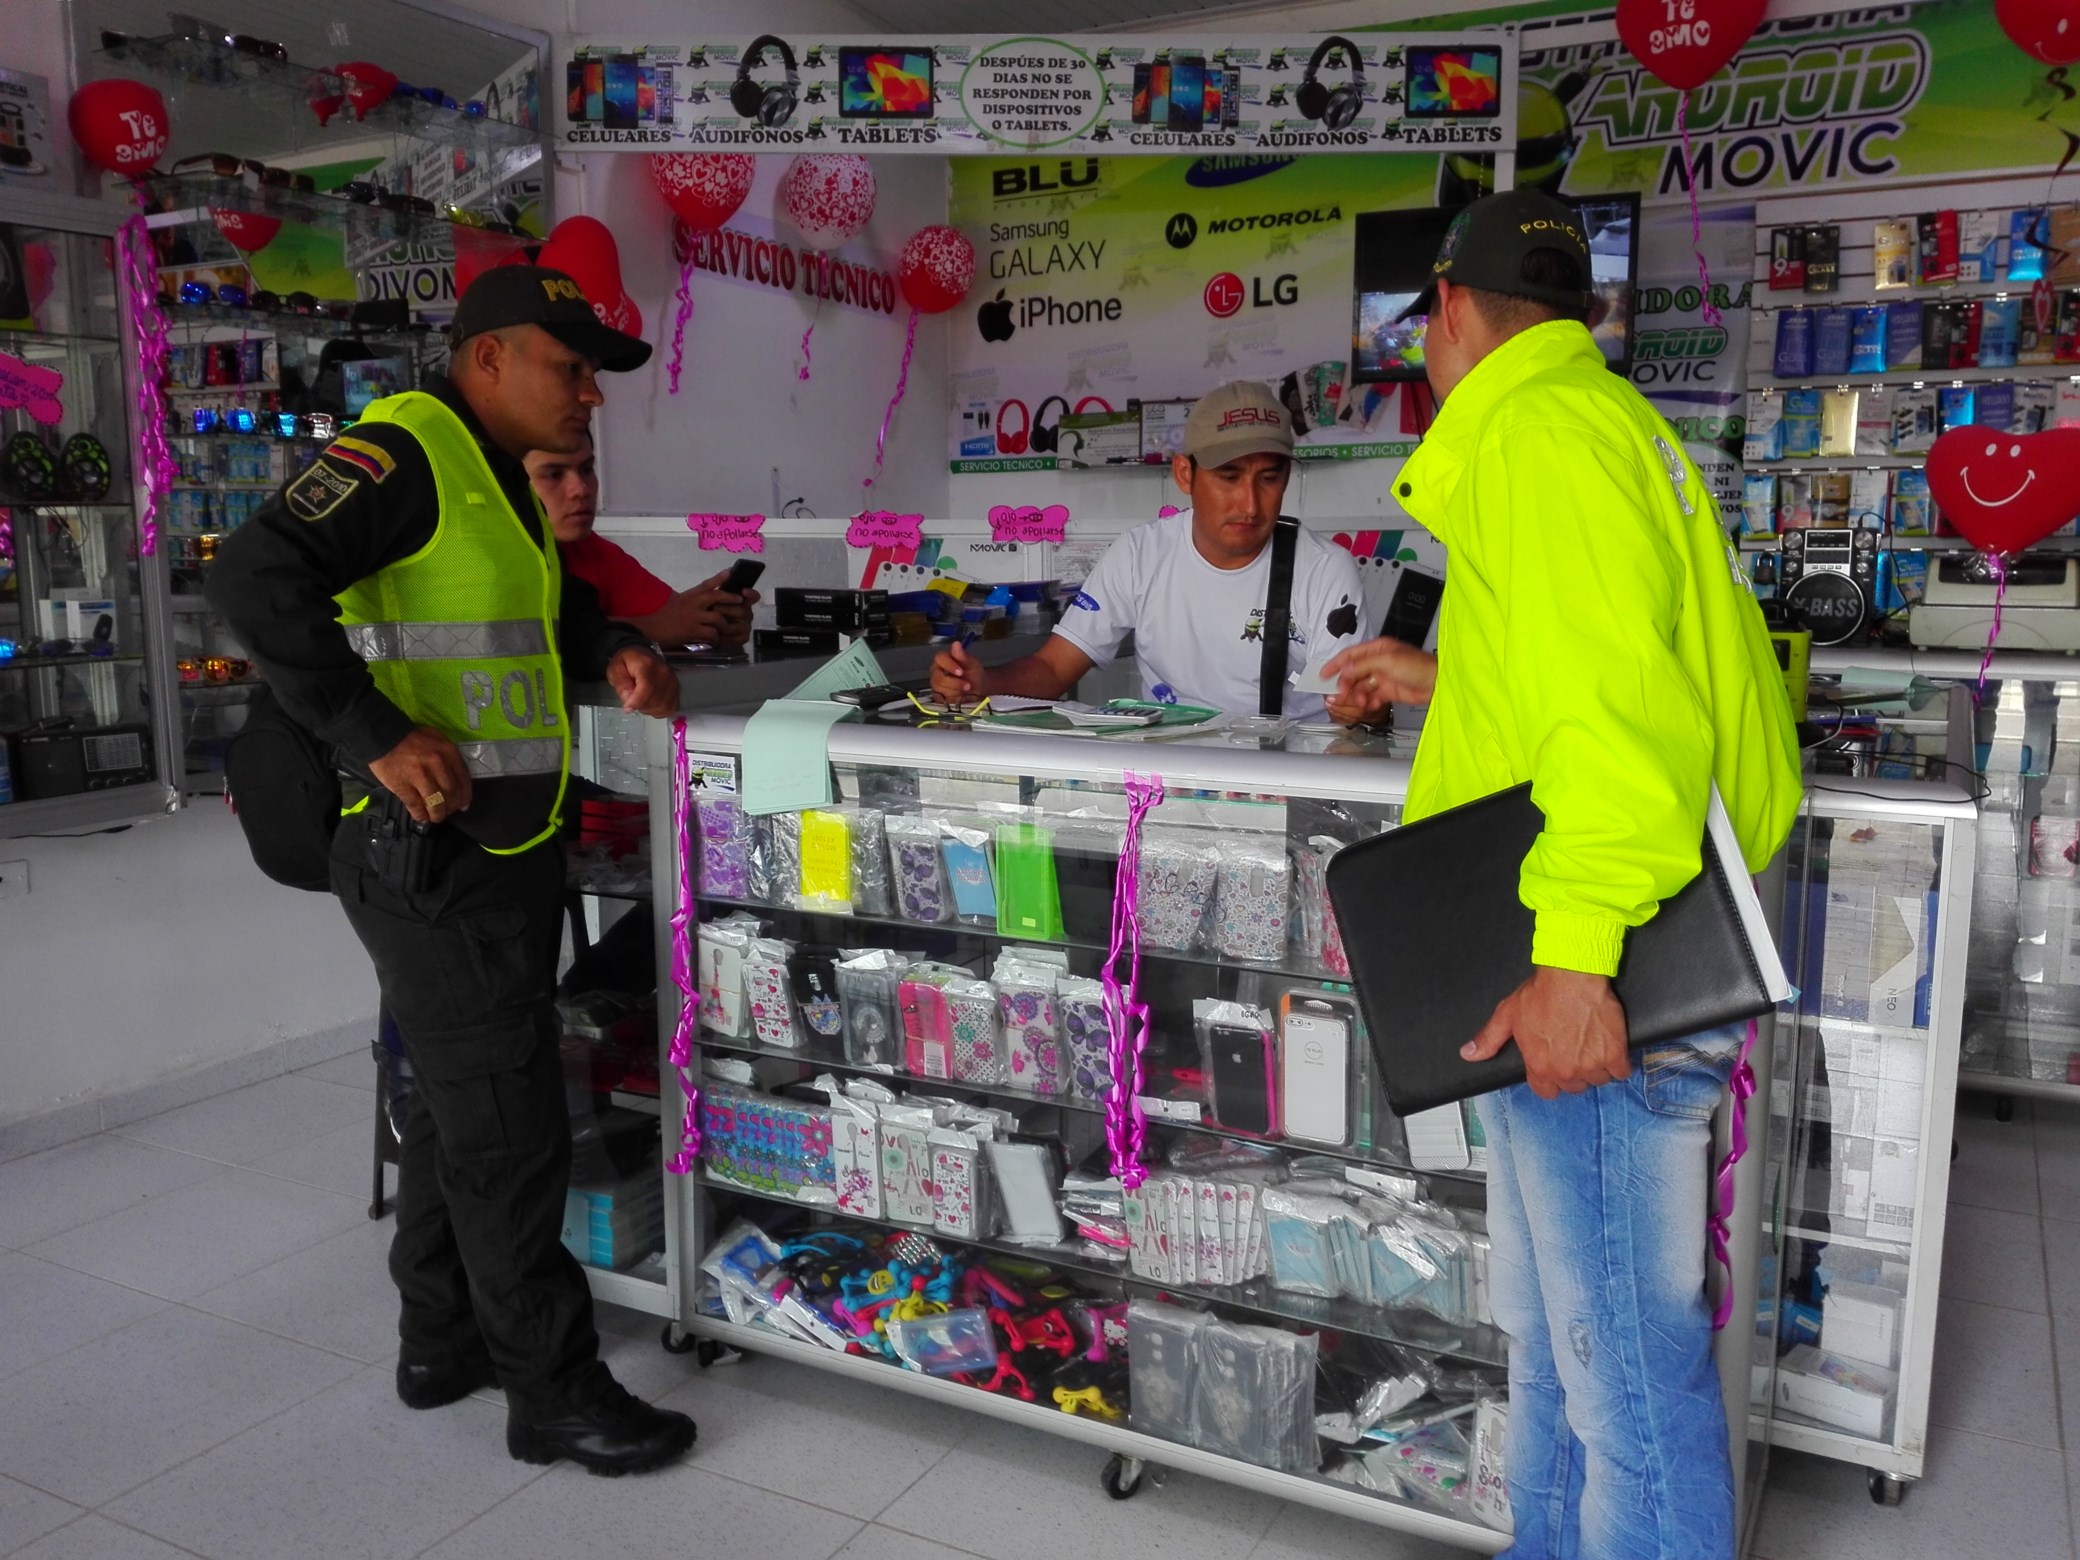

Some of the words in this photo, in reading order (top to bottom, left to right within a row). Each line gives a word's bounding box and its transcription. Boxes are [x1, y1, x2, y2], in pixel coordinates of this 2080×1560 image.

[980, 55, 1045, 68] DESPÚES
[1048, 58, 1067, 68] DE
[1070, 60, 1086, 69] 30
[993, 73, 1028, 84] DIAS
[1031, 74, 1052, 84] NO
[1055, 74, 1073, 84] SE
[1585, 36, 1922, 143] ANDROID
[972, 88, 1060, 99] RESPONDEN
[1063, 89, 1092, 100] POR
[982, 104, 1082, 116] DISPOSITIVOS
[118, 109, 157, 140] Te
[566, 130, 671, 144] CELULARES
[691, 130, 804, 144] AUDIFONOS
[838, 127, 937, 144] TABLETS
[992, 120, 1002, 130] O
[1005, 120, 1072, 131] TABLETS.
[1130, 133, 1236, 147] CELULARES
[1256, 131, 1368, 147] AUDIFONOS
[1404, 126, 1502, 144] TABLETS
[1659, 122, 1899, 194] MOVIC
[993, 157, 1099, 197] BLU
[990, 219, 1070, 243] Samsung
[1207, 205, 1343, 235] MOTOROLA
[1520, 219, 1588, 253] POLICIA
[672, 217, 797, 291] SERVICIO
[801, 248, 896, 315] TECNICO
[990, 239, 1107, 279] GALAXY
[1252, 273, 1299, 308] LG
[1020, 295, 1123, 329] iPhone
[1217, 408, 1280, 428] JESUS
[1352, 444, 1403, 457] SERVICIO
[959, 461, 1000, 472] SERVICIO
[1003, 460, 1043, 471] TECNICO
[313, 466, 349, 494] 07-2010
[702, 529, 715, 539] no
[855, 528, 869, 537] no
[1004, 526, 1018, 536] no
[460, 668, 559, 732] POL
[1886, 987, 1897, 1011] NEO
